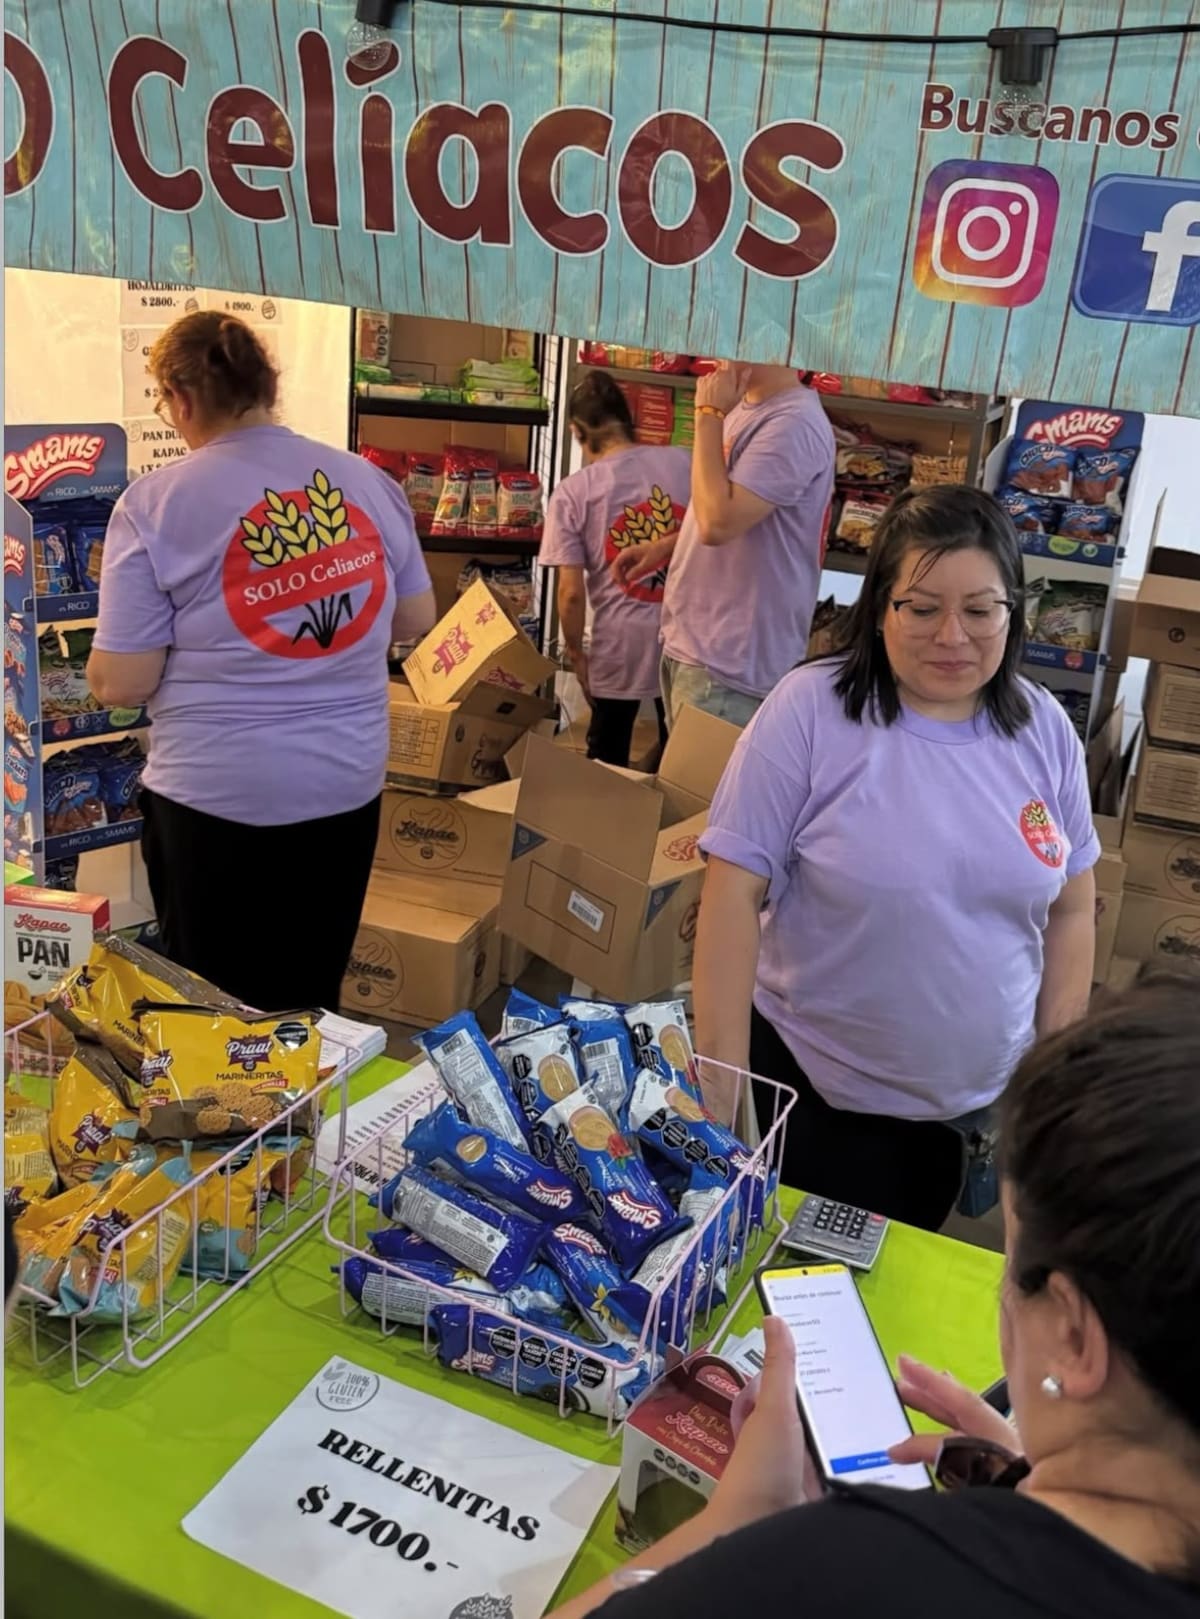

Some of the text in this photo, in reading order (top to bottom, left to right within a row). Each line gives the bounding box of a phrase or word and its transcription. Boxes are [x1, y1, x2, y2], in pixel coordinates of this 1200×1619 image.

[143, 432, 163, 441] PAN
[243, 550, 377, 606] SOLO Celiacos
[18, 937, 70, 968] PAN
[345, 1372, 370, 1387] 100%
[317, 1428, 541, 1541] RELLENITAS
[297, 1484, 460, 1572] $ 1700.-
